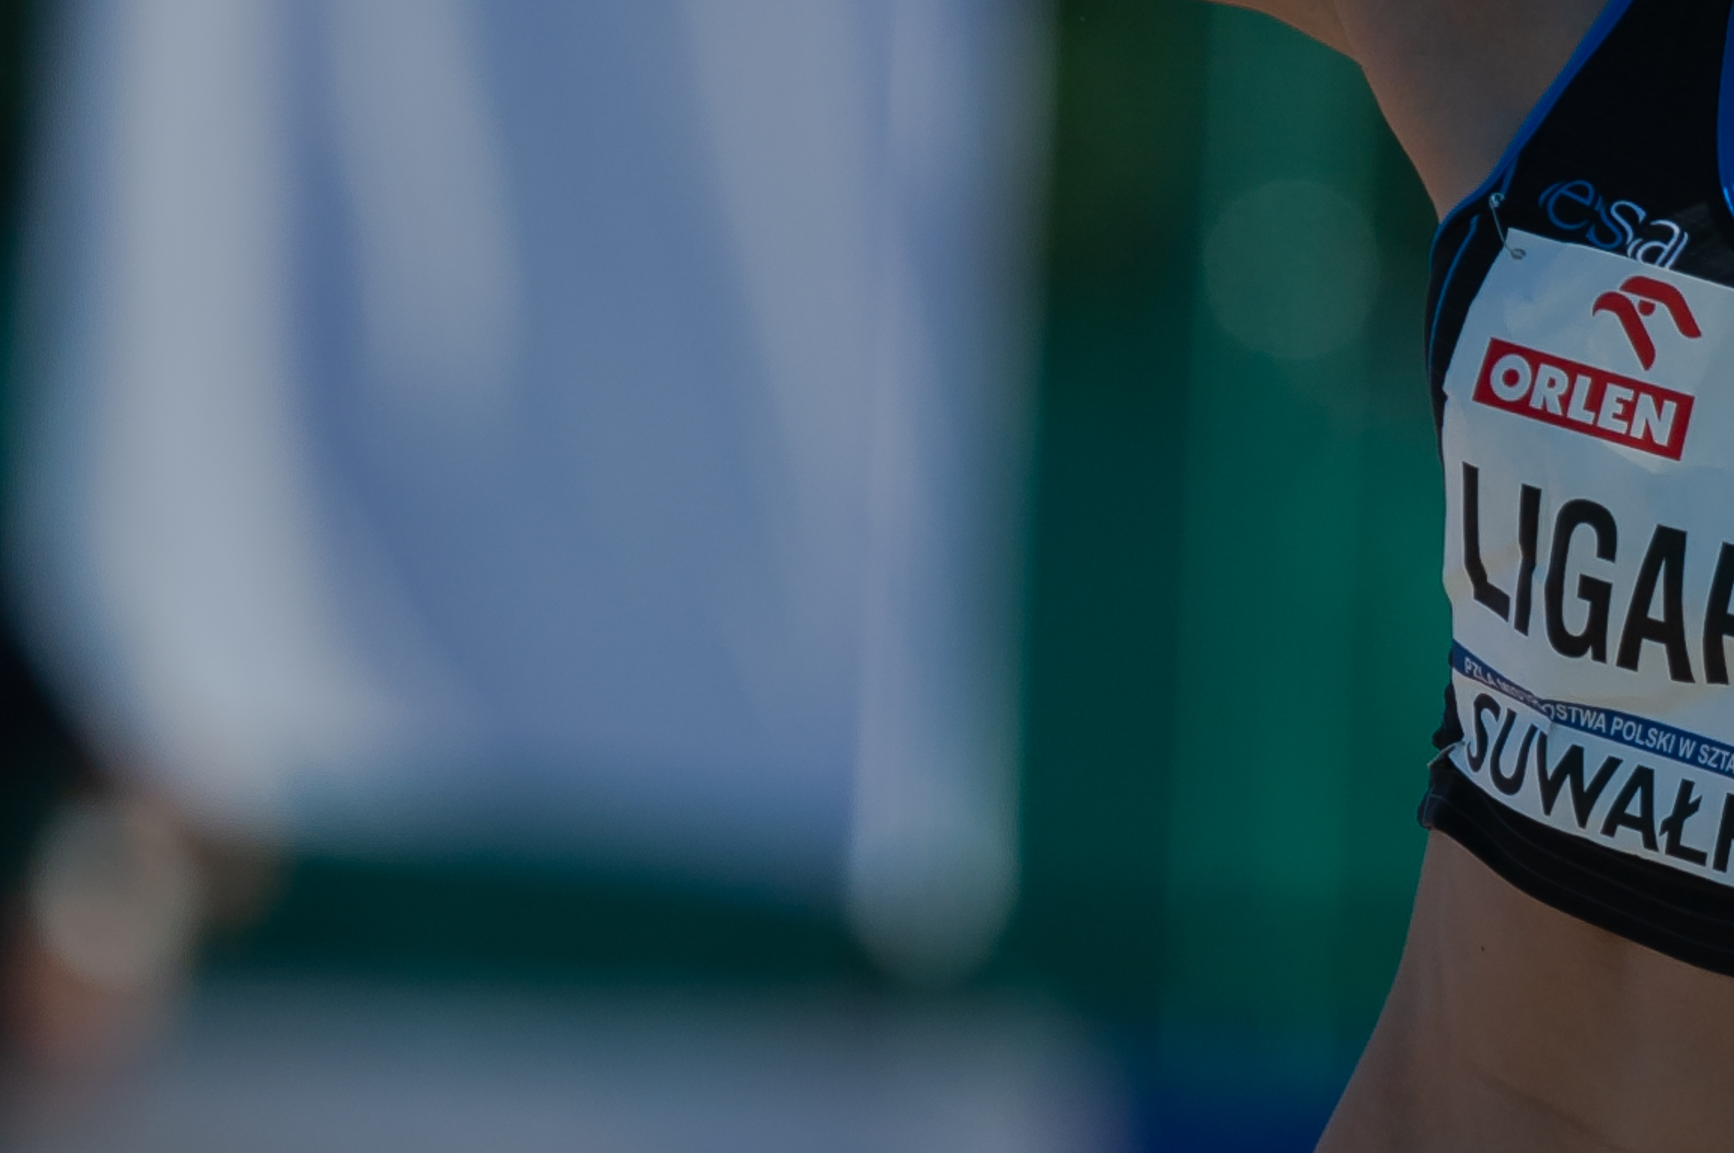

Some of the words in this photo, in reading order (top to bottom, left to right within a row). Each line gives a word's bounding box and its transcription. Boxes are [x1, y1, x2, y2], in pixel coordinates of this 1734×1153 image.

[1489, 351, 1680, 449] ORLEN
[1609, 715, 1676, 754] POLSKI
[1678, 736, 1698, 760] W
